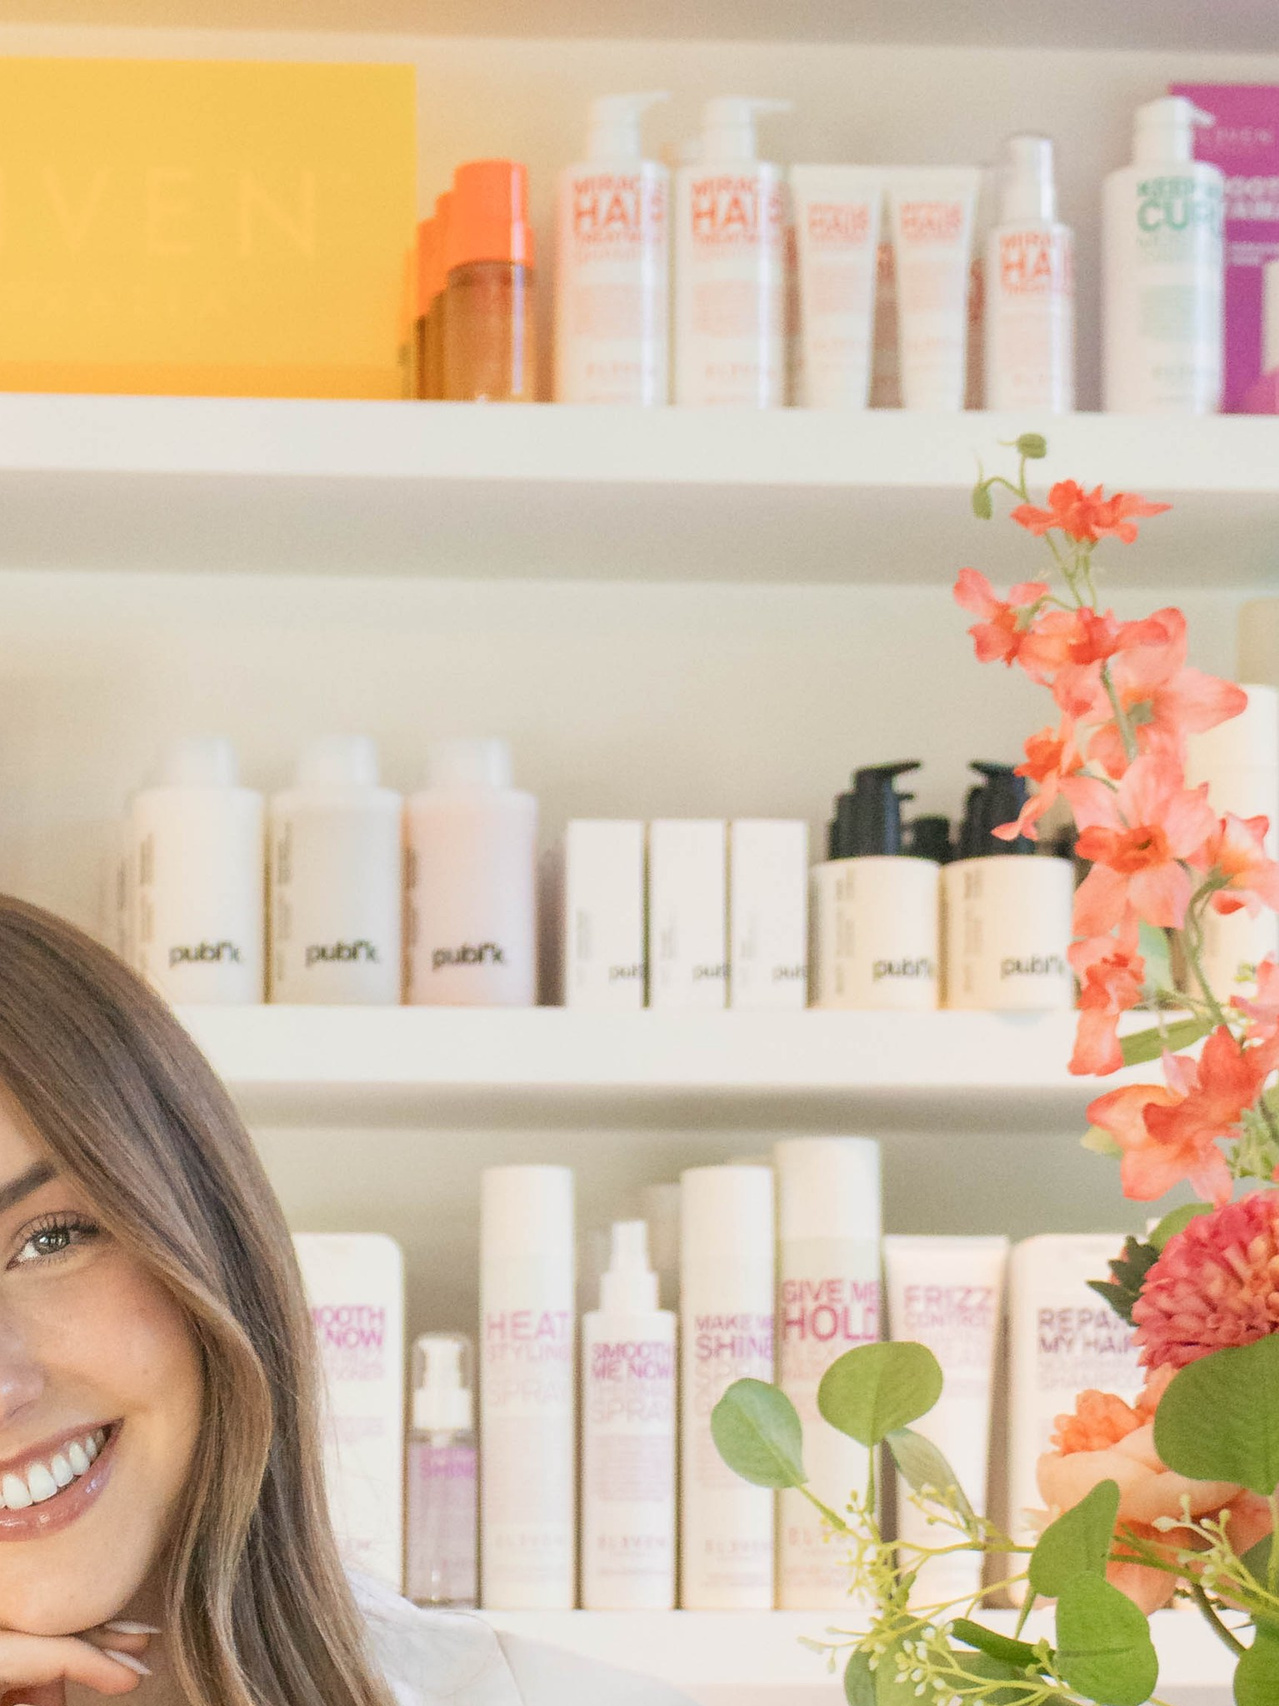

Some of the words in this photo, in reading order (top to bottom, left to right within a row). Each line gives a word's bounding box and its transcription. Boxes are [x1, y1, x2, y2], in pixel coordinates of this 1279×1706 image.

[782, 1279, 843, 1303] GIVE
[904, 1286, 993, 1313] FRIZZ
[486, 1309, 570, 1342] HEAT
[695, 1314, 750, 1332] MAKE
[325, 1328, 384, 1349] NOW
[1039, 1335, 1075, 1354] MY
